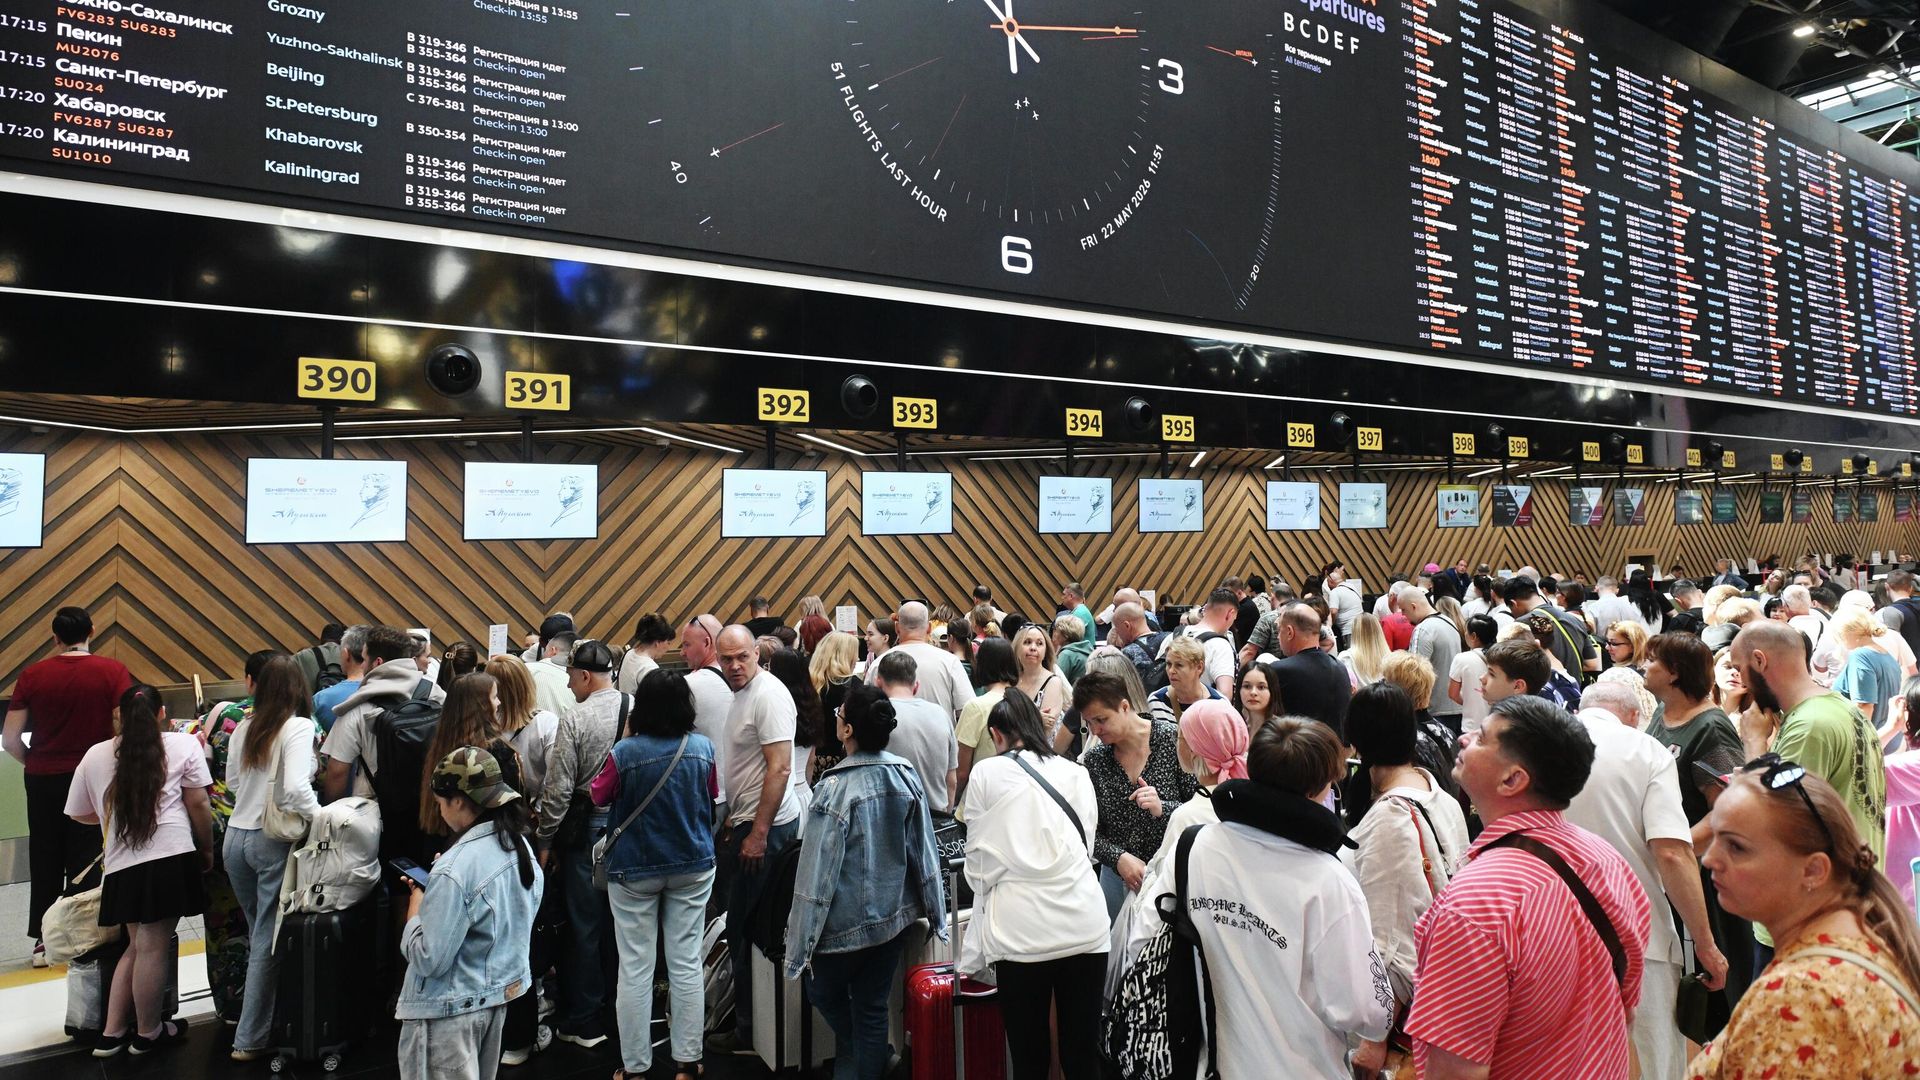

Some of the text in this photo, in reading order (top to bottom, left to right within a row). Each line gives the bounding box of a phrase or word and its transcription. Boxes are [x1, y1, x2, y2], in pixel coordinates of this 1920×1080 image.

[57, 7, 176, 38] FV6283 SU6283
[59, 0, 234, 35] жно-Сахалинск
[267, 0, 326, 23] Grozny
[473, 0, 548, 24] Check-in 13:55
[551, 6, 578, 20] 13:55
[1302, 0, 1385, 33] partures
[1, 14, 47, 33] 17:15
[57, 22, 122, 47] Пекин
[1284, 11, 1360, 55] B C D E F
[56, 42, 120, 62] MU2076
[266, 31, 403, 69] Yuzhno-Sakhalinsk
[407, 32, 466, 53] B 319-346
[0, 50, 46, 68] 17:15
[407, 44, 466, 65] B 355-364
[473, 46, 566, 74] Регистрация идет
[55, 58, 228, 100] Санкт-Петербург
[266, 62, 325, 87] Beijing
[407, 62, 466, 82] B 319-346
[473, 58, 545, 80] Check-in open
[1158, 58, 1184, 95] 3
[0, 86, 45, 104] 17:20
[54, 77, 104, 94] SU024
[407, 74, 466, 94] B 355-364
[473, 75, 566, 102] Регистрация идет
[53, 92, 166, 123] Хабаровск
[406, 92, 465, 112] C 376-381
[473, 87, 545, 109] Check-in open
[265, 95, 378, 128] St.Petersburg
[473, 105, 539, 124] Регистрация
[551, 118, 578, 132] 13:00
[53, 112, 174, 139] FV6287 SU6287
[406, 123, 466, 142] B 350-354
[473, 117, 548, 137] Check-in 13:00
[53, 127, 190, 163] Калининград
[265, 127, 363, 154] Khabarovsk
[473, 134, 566, 159] Регистрация идет
[831, 61, 948, 222] 51 FLIGHTS LAST HOUR
[52, 147, 112, 165] SU1010
[406, 153, 466, 171] B 319-346
[473, 146, 545, 166] Check-in open
[1421, 153, 1441, 167] 18:00
[265, 160, 360, 185] Kaliningrad
[406, 165, 466, 183] B 355-364
[473, 164, 566, 188] Регистрация идет
[670, 160, 687, 185] 40
[405, 184, 465, 201] B 319-346
[473, 176, 545, 195] Check-in open
[1080, 143, 1164, 250] FRI 22 MAY 2026 11:51
[405, 196, 465, 213] B 355-364
[472, 205, 545, 224] Check-in open
[473, 193, 566, 216] Регистрация идет
[1001, 235, 1033, 275] 6
[1250, 264, 1261, 281] 20
[303, 364, 372, 394] 390
[510, 377, 564, 404] 391
[762, 393, 807, 417] 392
[896, 402, 935, 424] 393
[1069, 413, 1100, 432] 394
[1165, 419, 1192, 437] 395
[1290, 427, 1313, 443] 396
[1360, 431, 1380, 446] 397
[1455, 436, 1473, 451] 398
[1510, 440, 1527, 454] 399
[1585, 446, 1599, 458] 400
[1628, 448, 1641, 460] 401
[1688, 452, 1700, 463] 402
